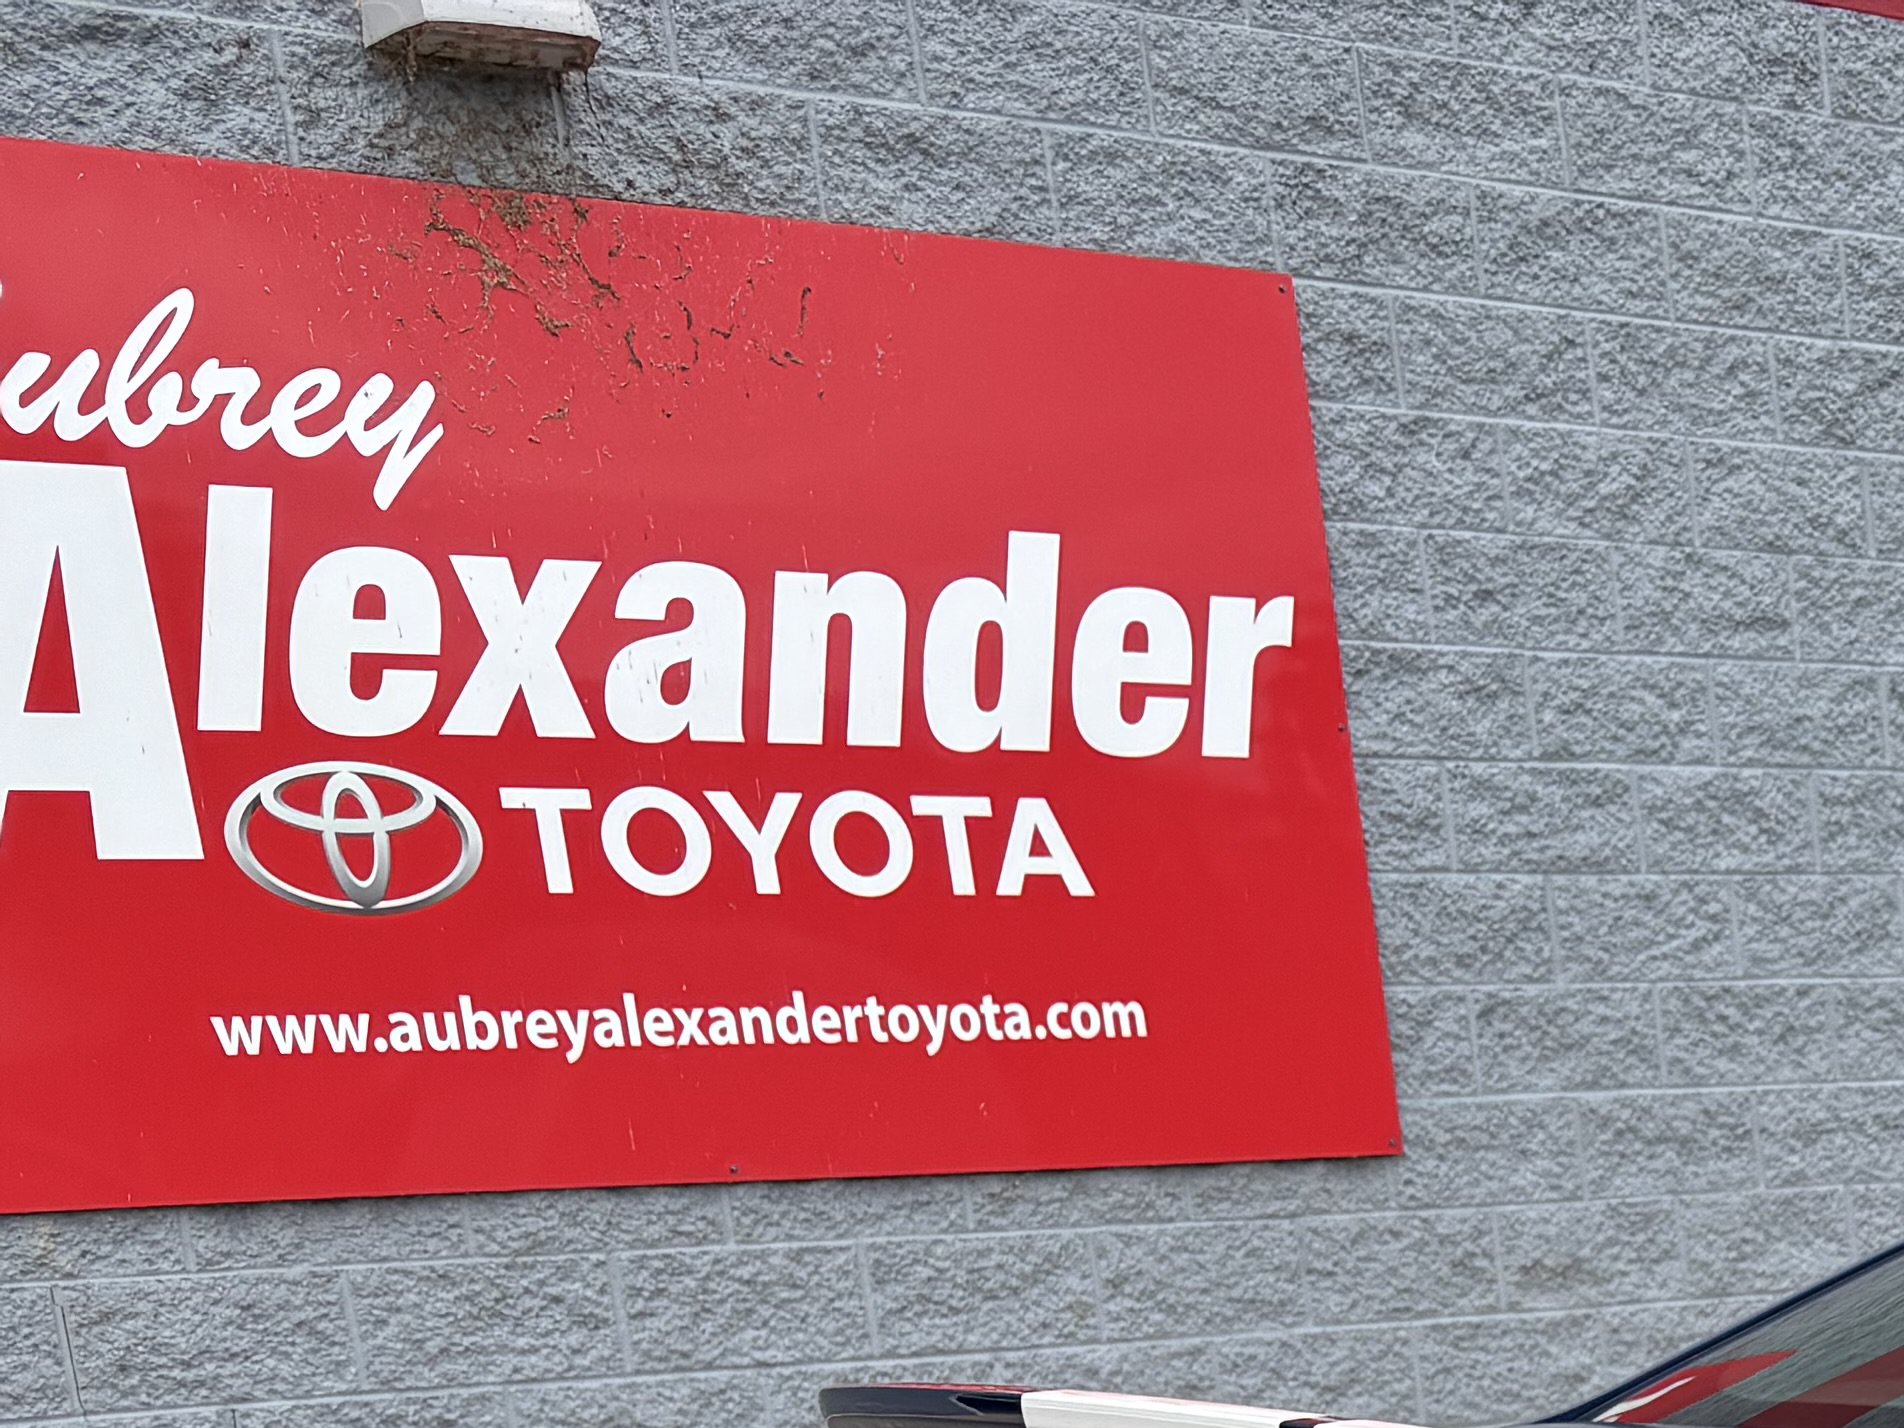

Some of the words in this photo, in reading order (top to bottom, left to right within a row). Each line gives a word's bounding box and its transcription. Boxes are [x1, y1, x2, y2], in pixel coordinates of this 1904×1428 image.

[0, 286, 445, 512] ubrey
[0, 458, 1295, 862] Alexander
[498, 786, 1096, 899] TOYOTA
[210, 991, 1148, 1064] www.aubreyalexandertoyota.com
